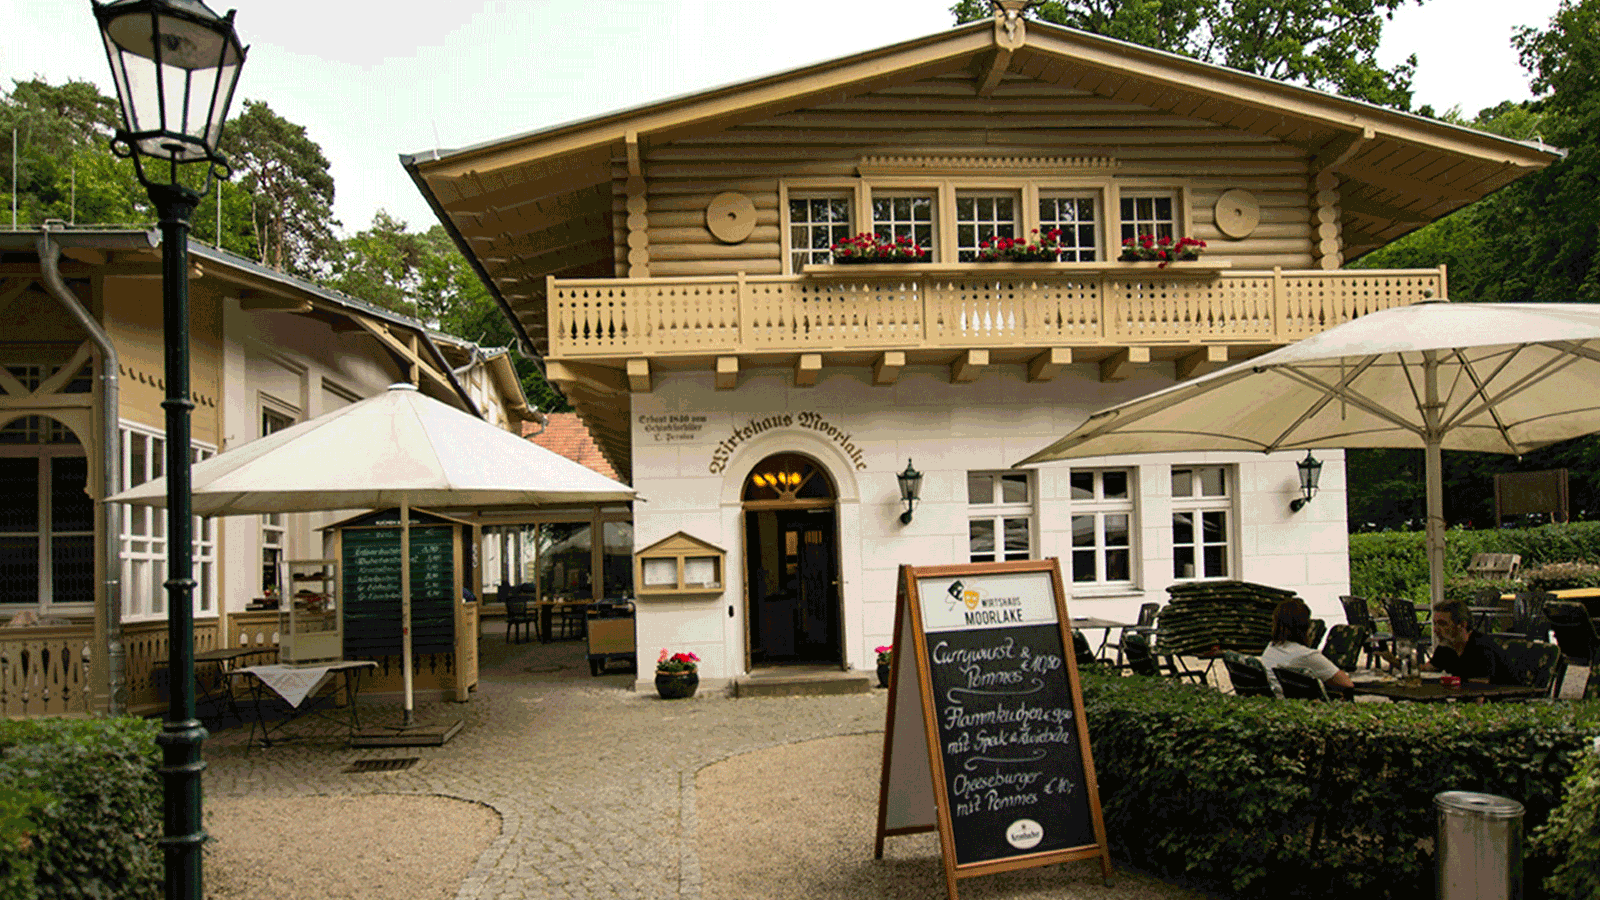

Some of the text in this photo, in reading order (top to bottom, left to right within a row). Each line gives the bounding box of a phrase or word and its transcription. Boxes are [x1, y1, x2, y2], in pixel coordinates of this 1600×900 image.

[709, 411, 867, 474] Wirtshaus Moorlake
[981, 597, 1022, 608] WIRTSHAUS
[964, 608, 1023, 626] MOORLAKE
[933, 637, 1014, 674] Currywurst
[965, 665, 1023, 689] Pommes
[944, 702, 1042, 730] Flammkuchen
[947, 732, 970, 755] mit
[953, 768, 1043, 799] Cheeseburger
[957, 789, 1038, 817] mit Pommes
